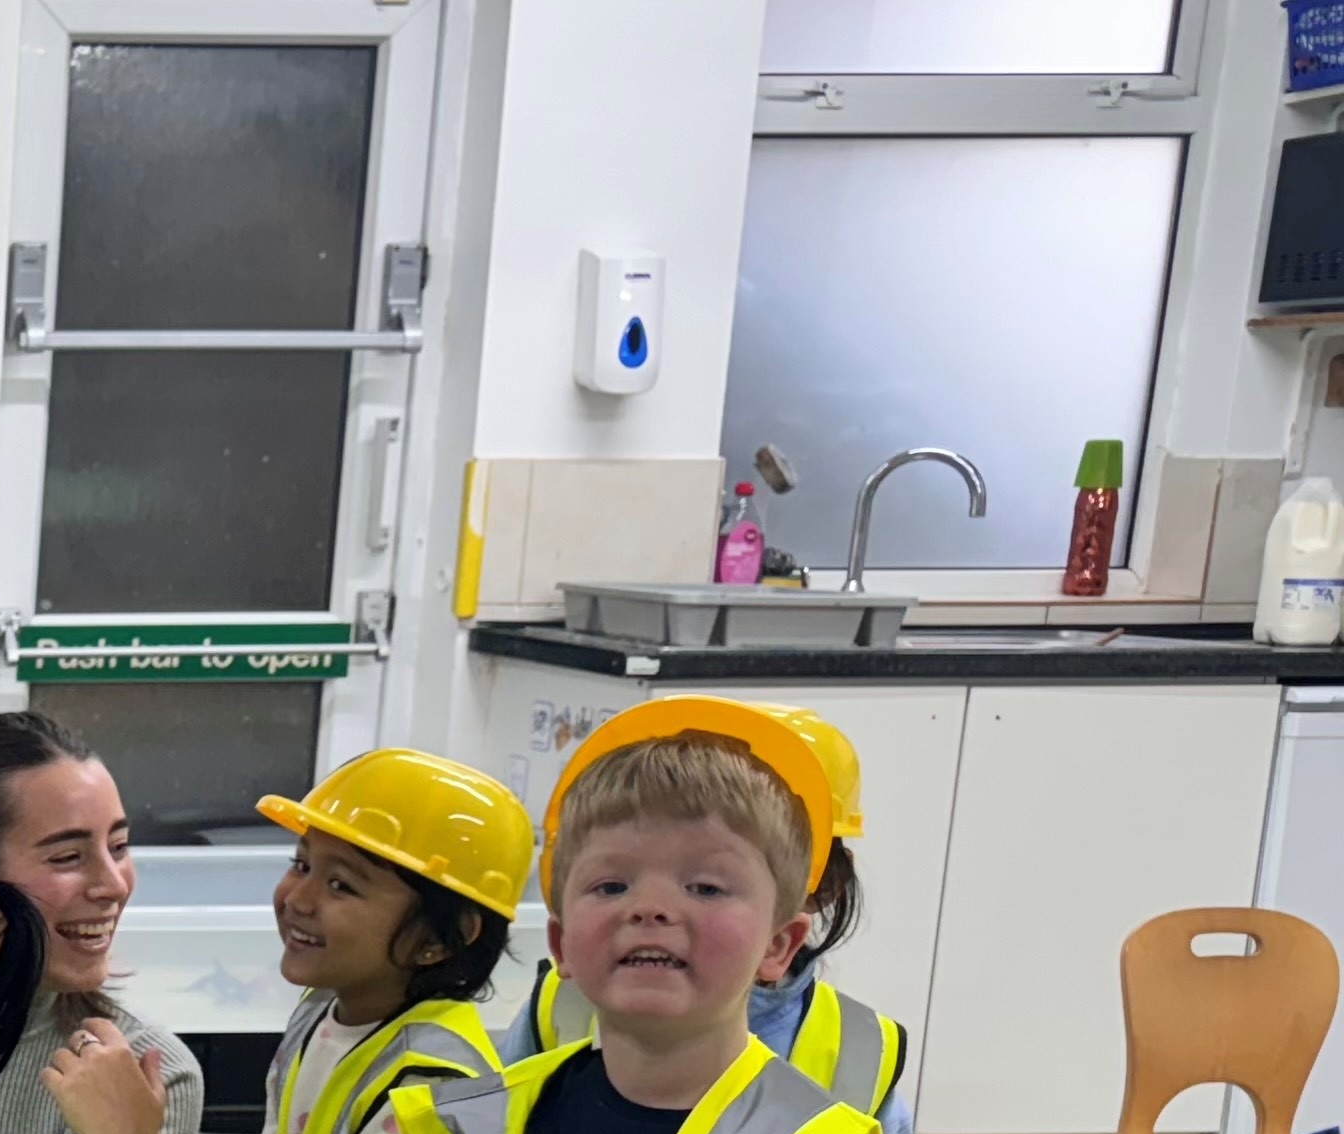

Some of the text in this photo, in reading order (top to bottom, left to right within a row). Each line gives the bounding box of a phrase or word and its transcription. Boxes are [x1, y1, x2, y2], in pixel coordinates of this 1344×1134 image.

[35, 637, 333, 676] Push bar to open
